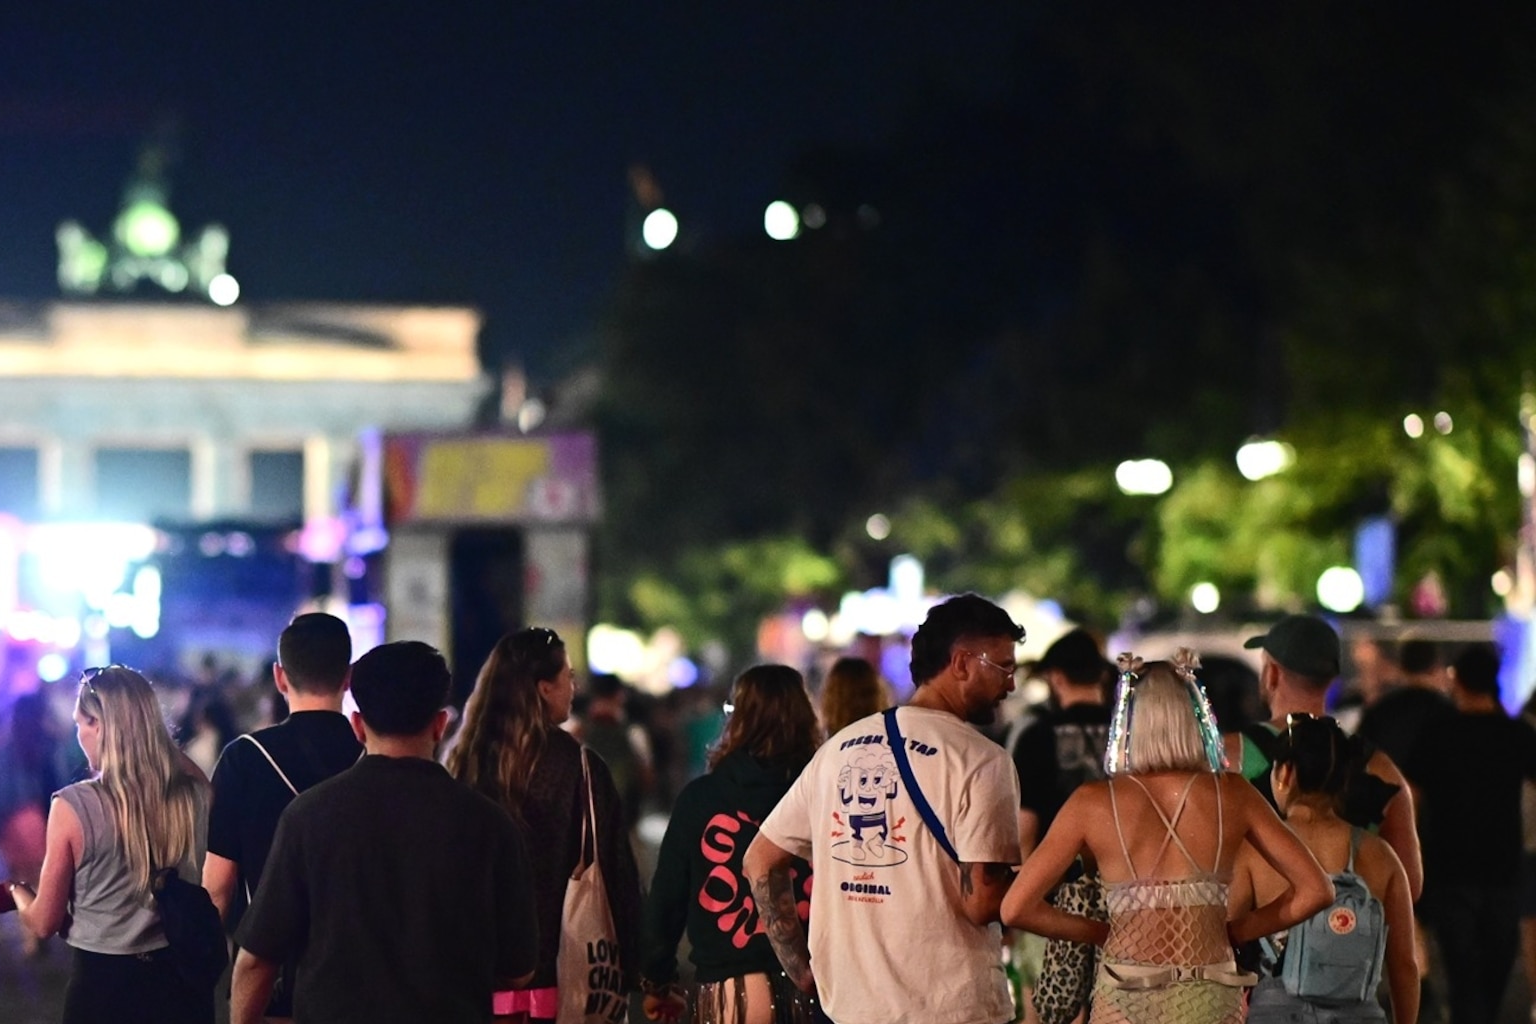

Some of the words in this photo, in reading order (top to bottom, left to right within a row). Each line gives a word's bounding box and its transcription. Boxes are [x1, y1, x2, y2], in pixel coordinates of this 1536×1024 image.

[840, 735, 884, 751] FRESH
[909, 740, 938, 756] TAP
[587, 939, 620, 965] LOV
[588, 966, 622, 994] CHA
